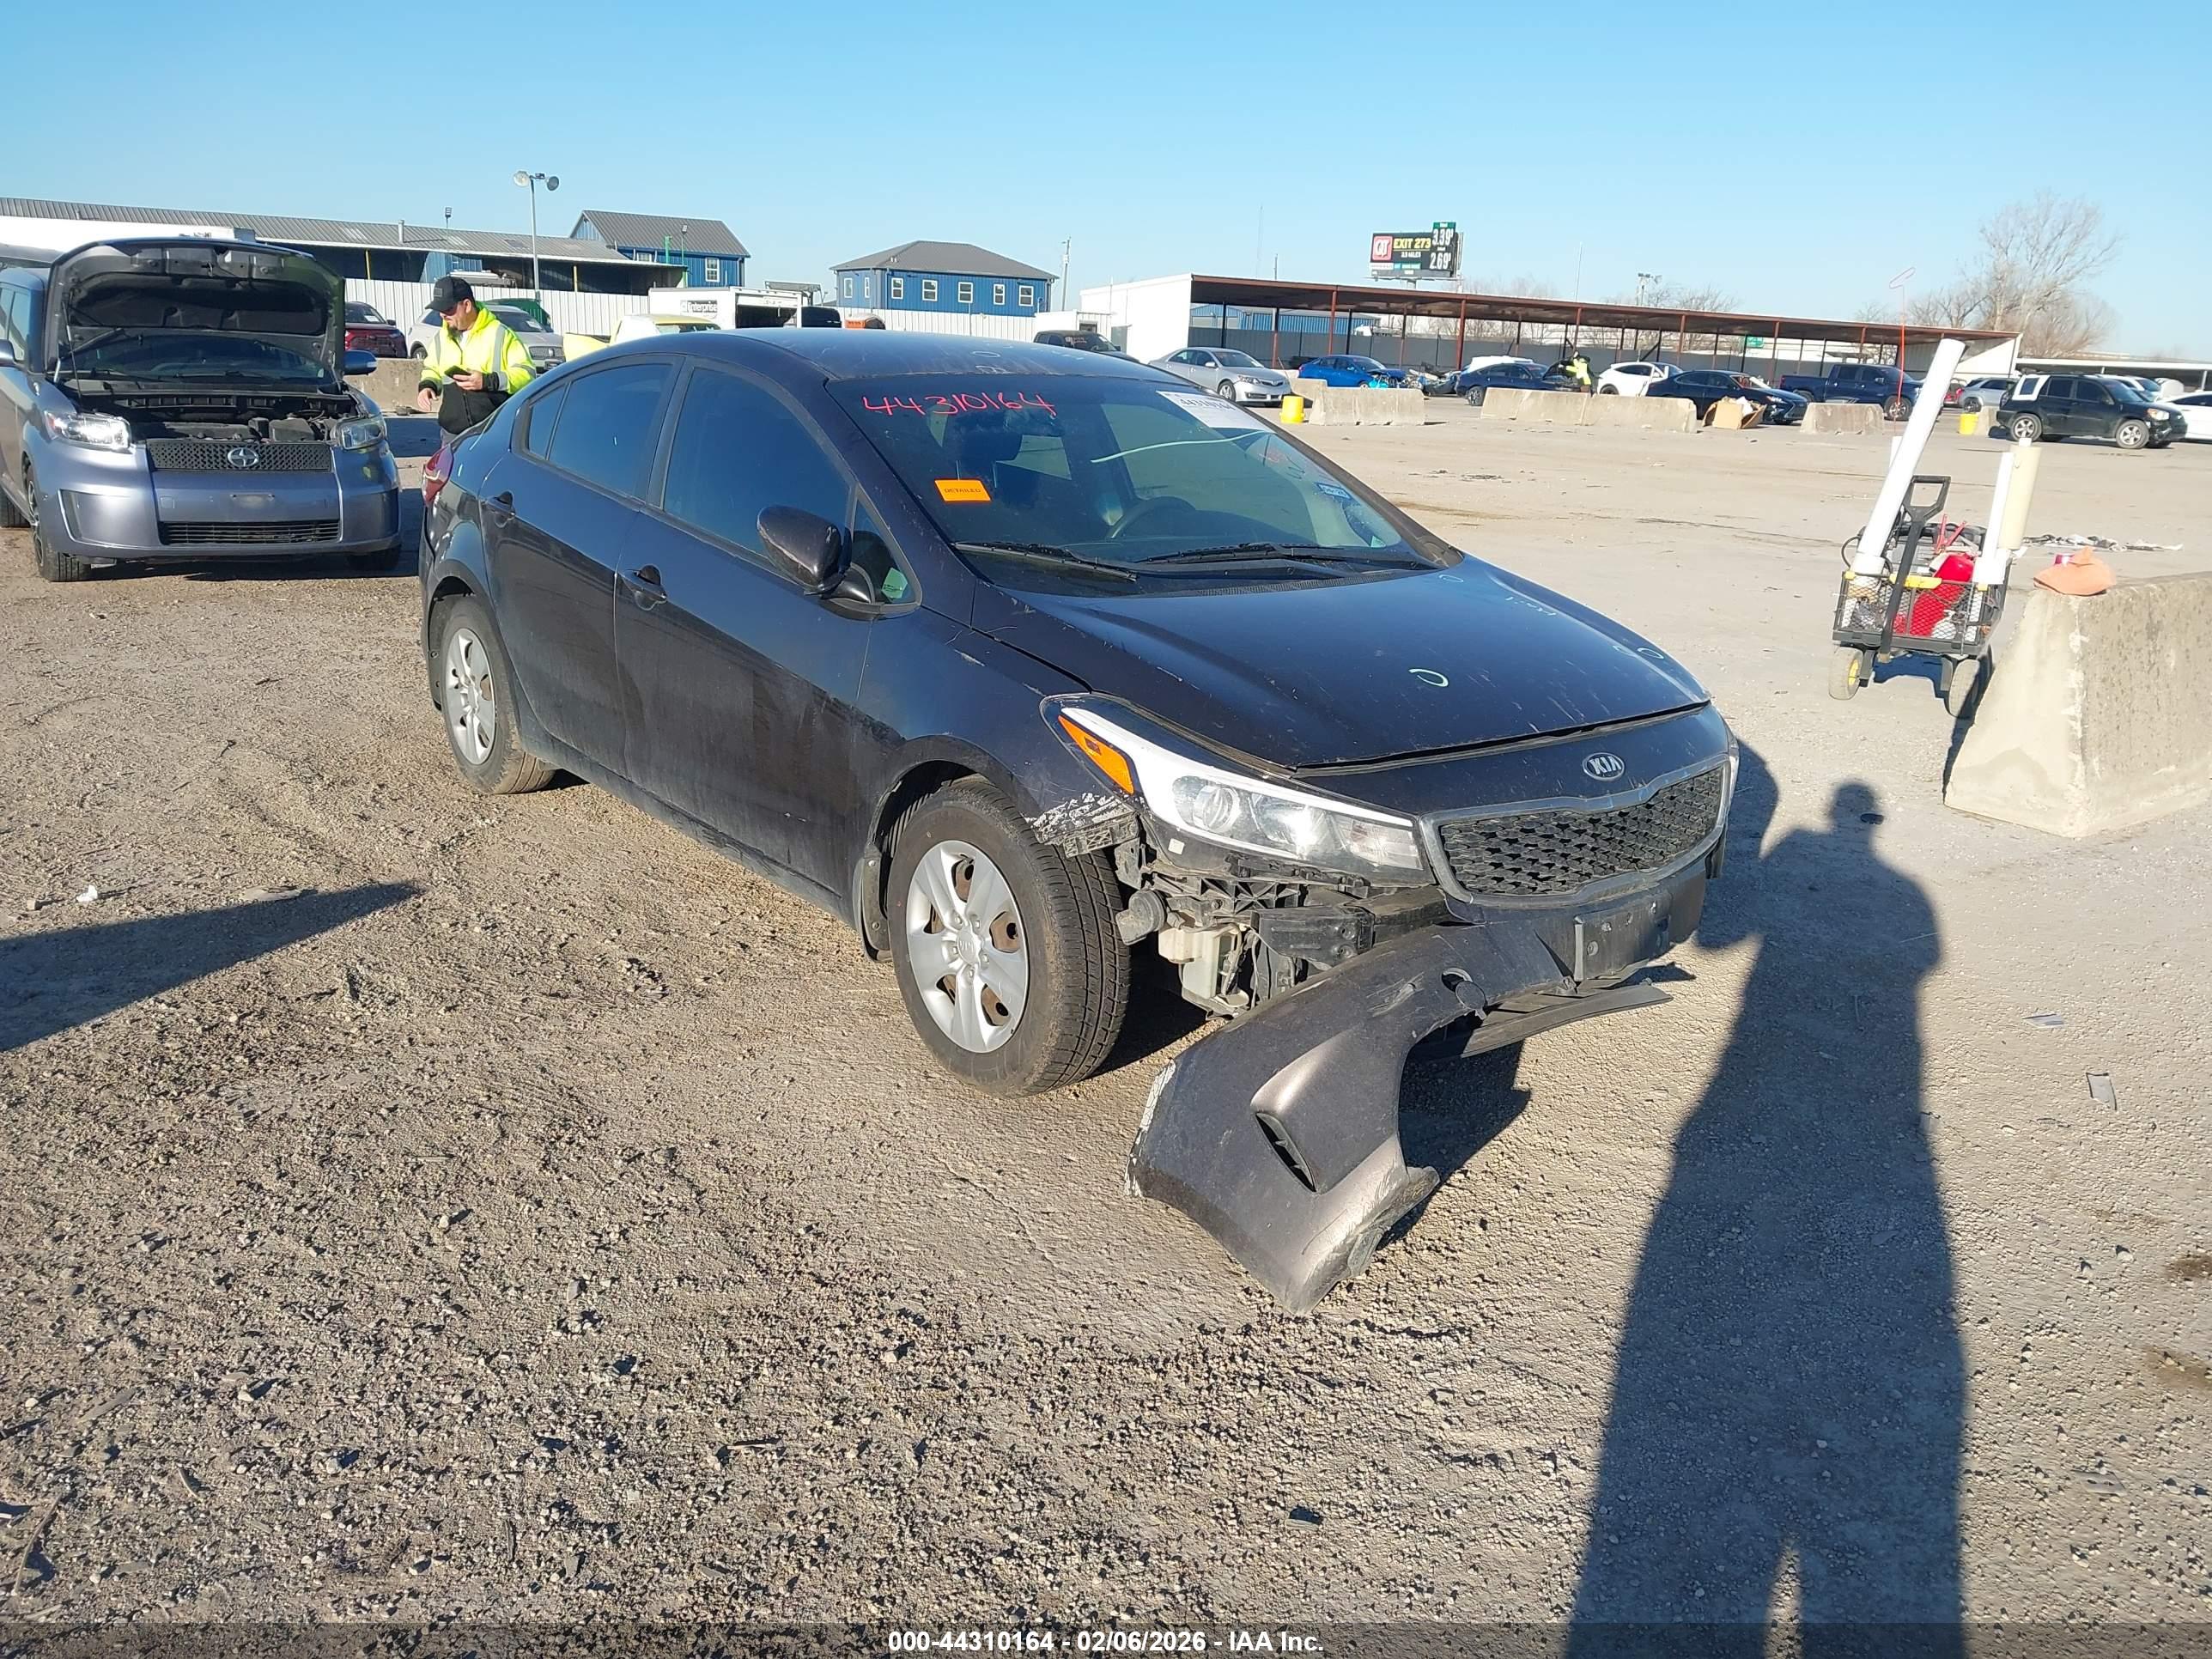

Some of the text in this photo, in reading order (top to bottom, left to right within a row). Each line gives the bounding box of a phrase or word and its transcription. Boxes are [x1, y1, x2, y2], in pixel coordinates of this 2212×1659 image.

[1375, 240, 1389, 257] QT
[1394, 238, 1431, 249] EXIT 273
[688, 301, 717, 313] Enterprise
[863, 392, 1056, 416] 44310164
[1589, 756, 1622, 775] KIA
